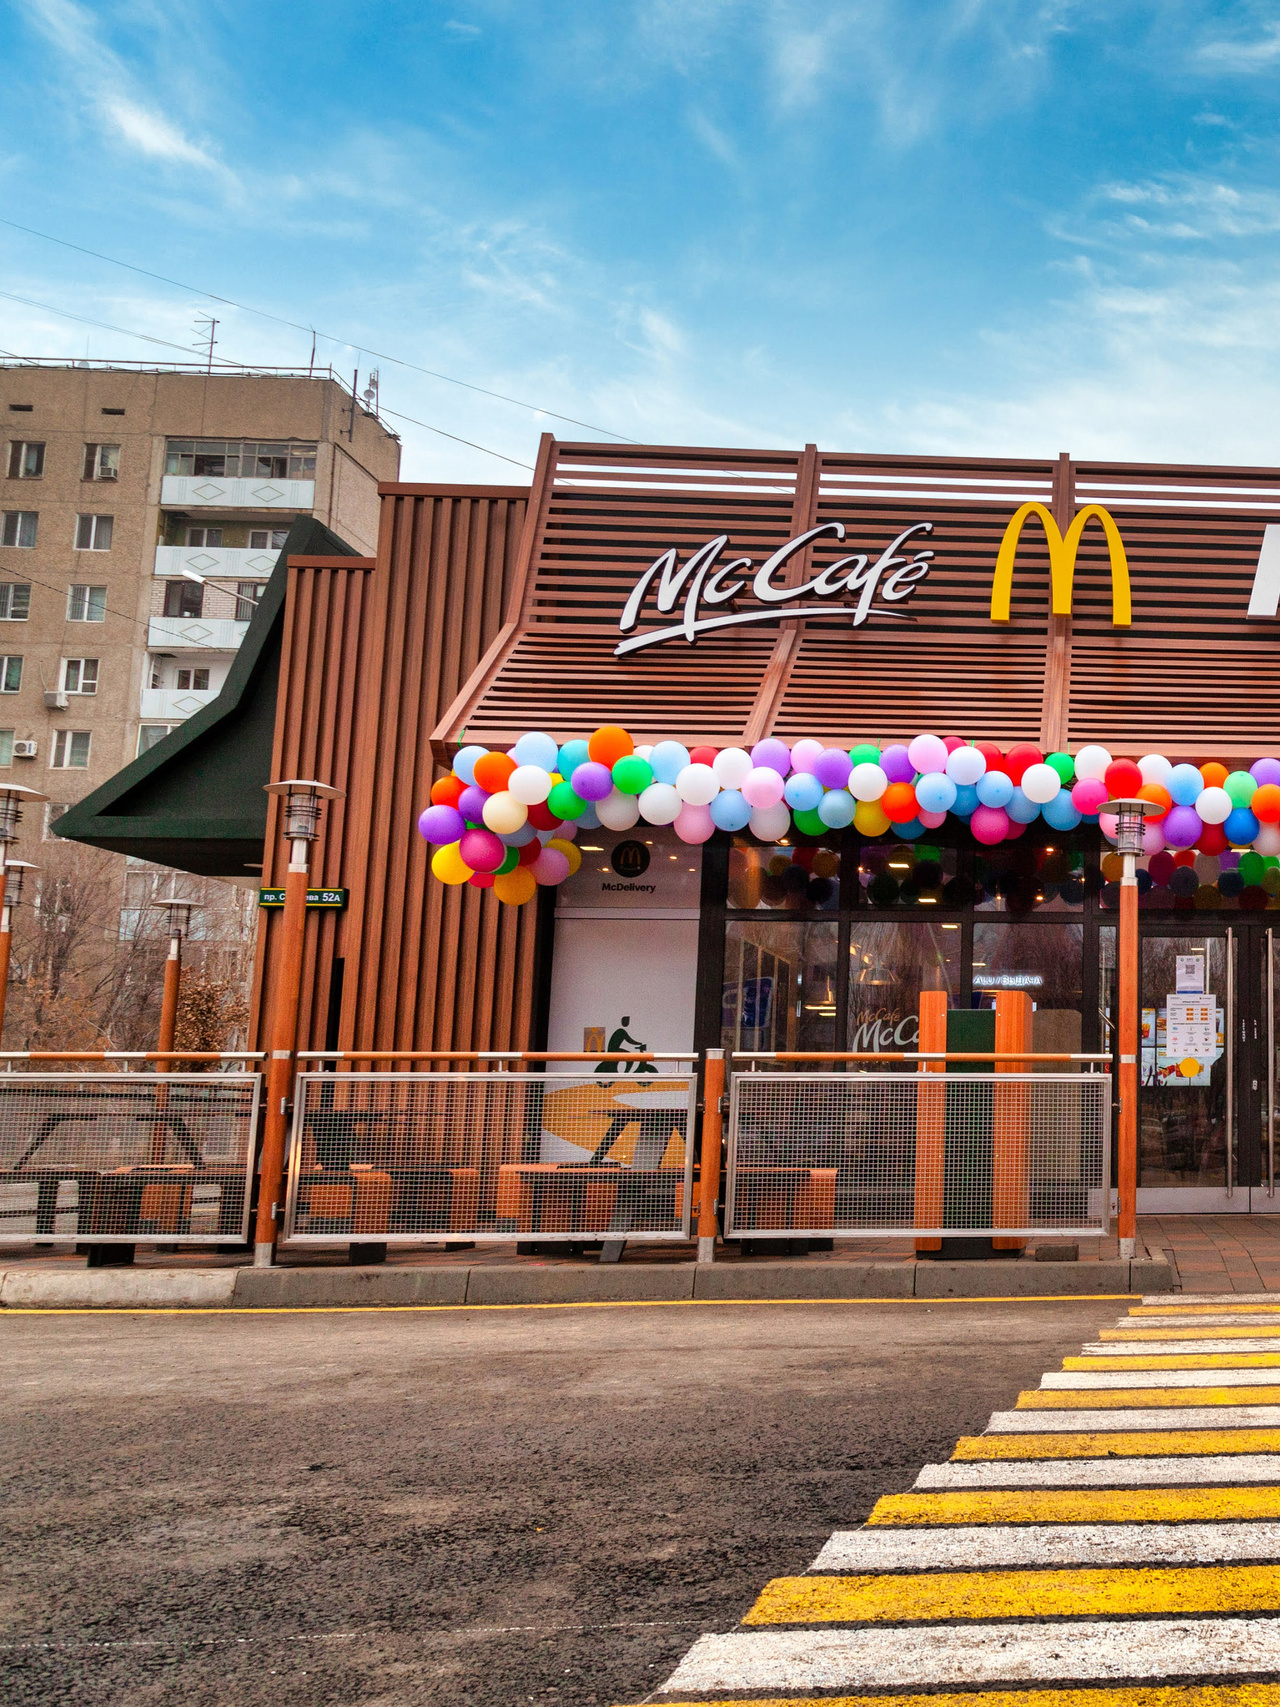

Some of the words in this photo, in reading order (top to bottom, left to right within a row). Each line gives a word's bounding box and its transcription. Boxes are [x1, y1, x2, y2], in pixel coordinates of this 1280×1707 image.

[614, 522, 935, 650] McCafé
[602, 883, 656, 893] McDelivery
[264, 894, 277, 902] пр.
